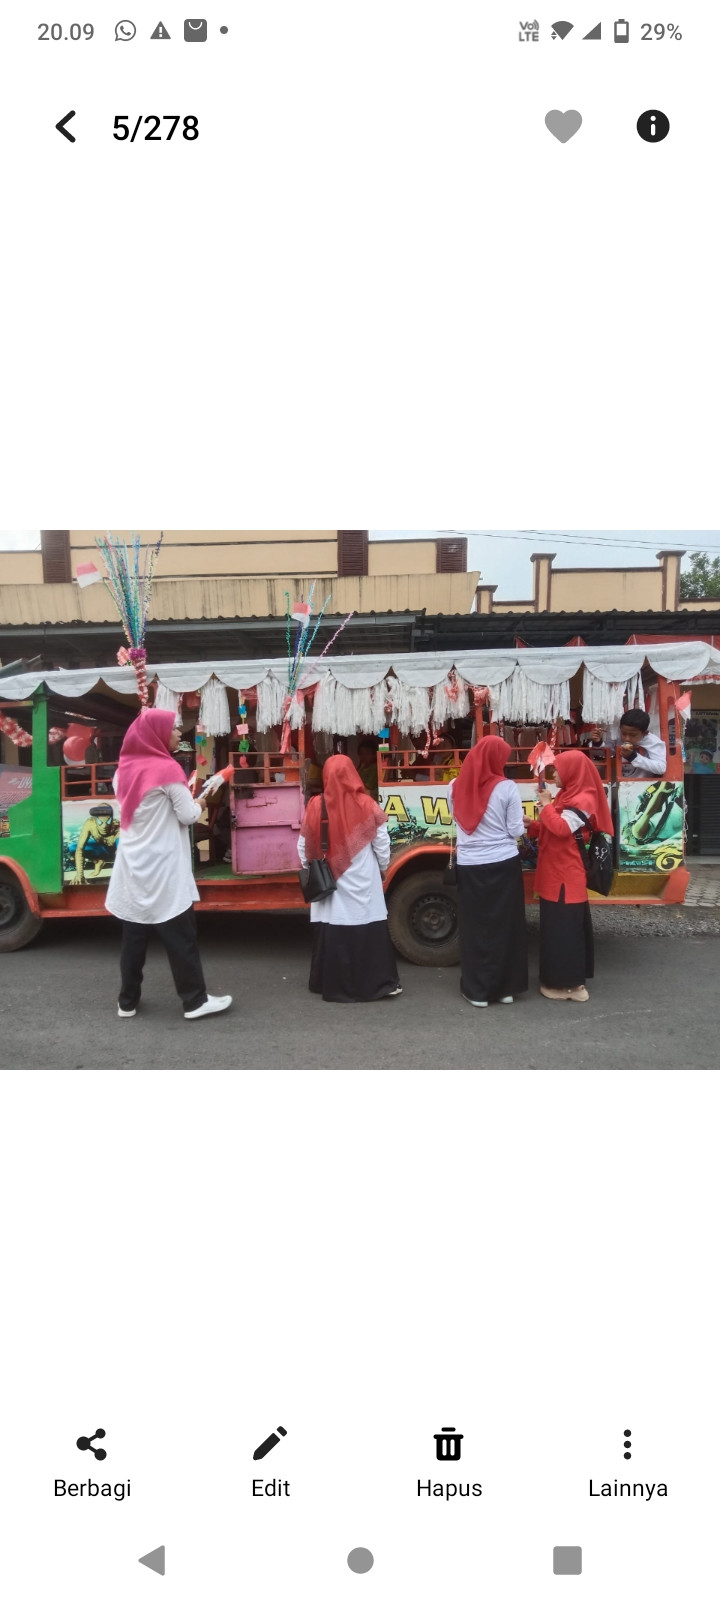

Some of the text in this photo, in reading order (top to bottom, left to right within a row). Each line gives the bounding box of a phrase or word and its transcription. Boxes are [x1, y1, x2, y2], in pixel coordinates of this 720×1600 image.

[37, 23, 95, 41] 20.09
[518, 31, 540, 42] LTE
[640, 23, 683, 41] 29%
[112, 114, 200, 143] 5/278
[54, 1478, 669, 1502] Berbagi Edit Hapus Lainnya
